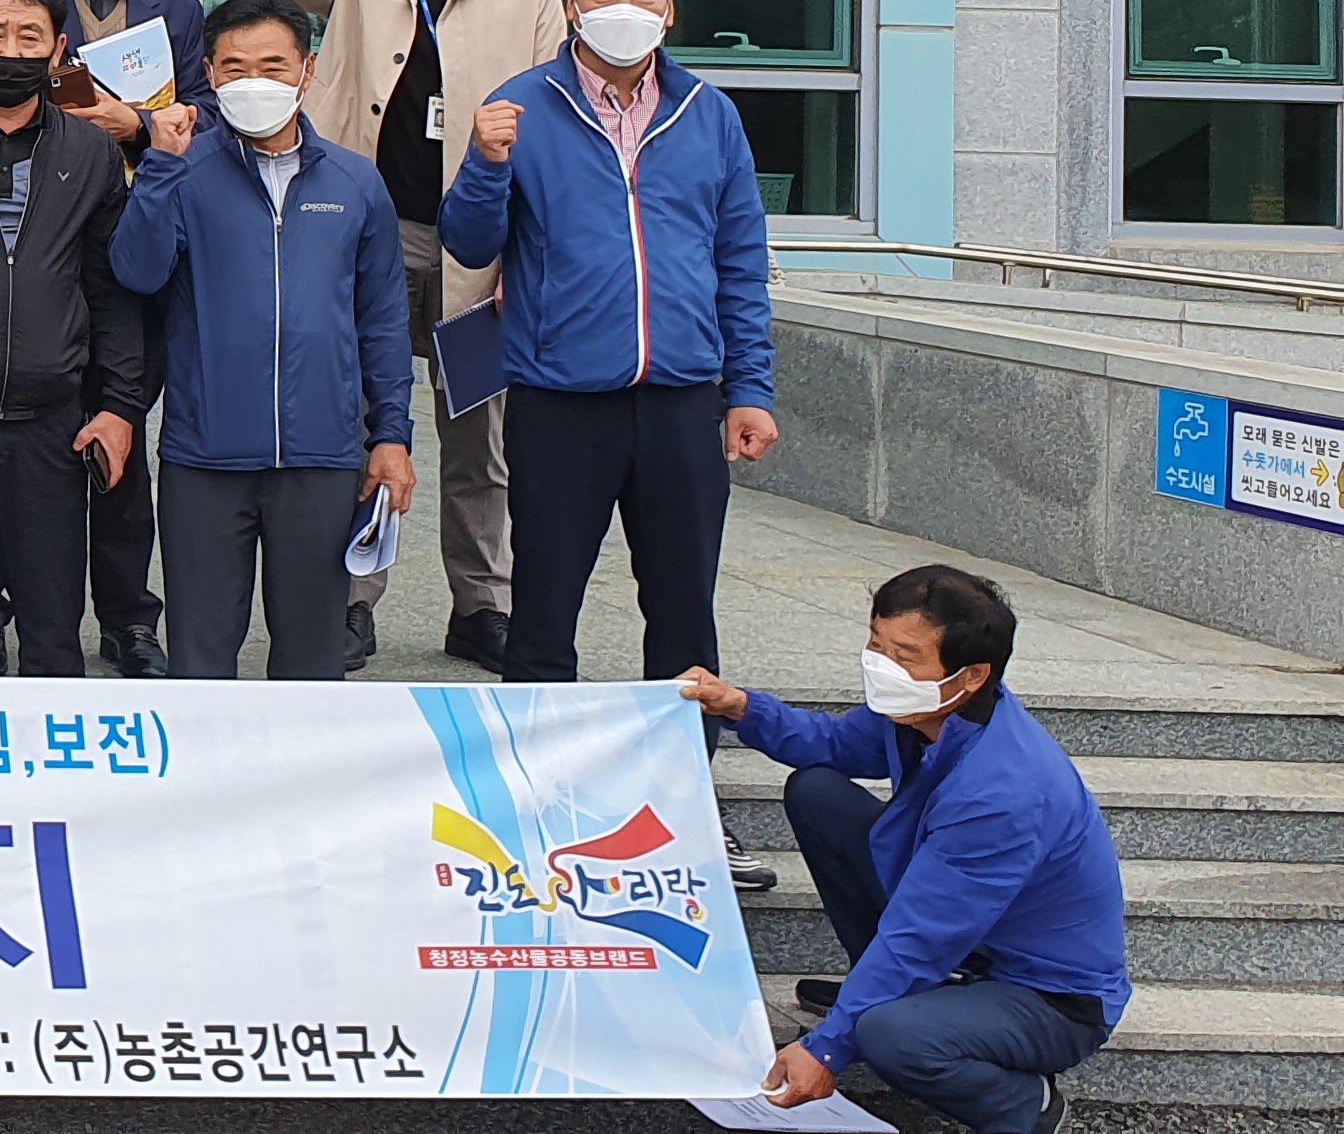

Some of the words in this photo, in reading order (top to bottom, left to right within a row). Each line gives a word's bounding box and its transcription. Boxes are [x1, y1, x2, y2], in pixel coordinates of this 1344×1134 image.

[1242, 425, 1267, 445] 모래
[1301, 435, 1340, 459] 신발은
[1242, 449, 1305, 479] 수돗가에서
[1165, 466, 1216, 496] 수도시설
[1240, 474, 1332, 510] 씻고들어오세요
[427, 948, 651, 968] 청정농수산물공동브랜드
[33, 1019, 424, 1084] (주)농촌공간연구소
